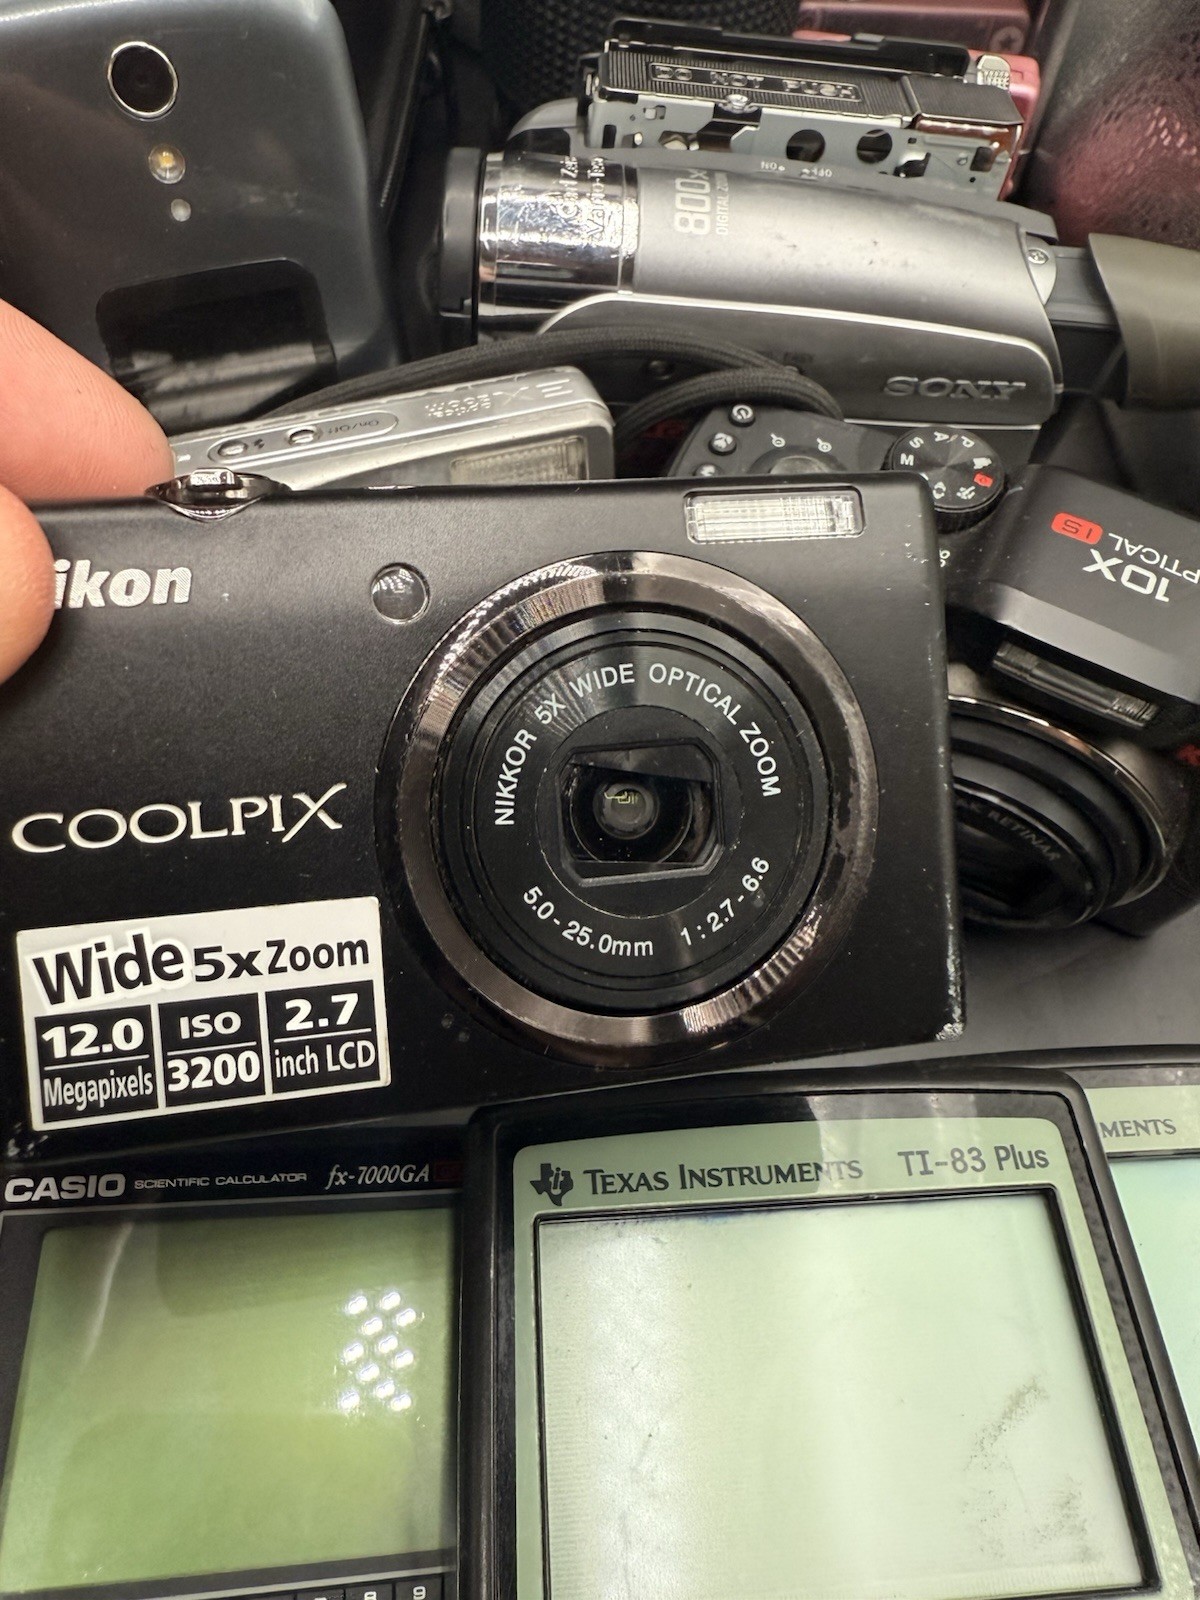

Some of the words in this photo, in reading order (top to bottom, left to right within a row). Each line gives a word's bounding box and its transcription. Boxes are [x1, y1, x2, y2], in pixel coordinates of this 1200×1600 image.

[709, 71, 765, 89] NOT
[715, 194, 730, 236] DIGITAL
[883, 375, 1027, 400] SONY
[326, 417, 380, 435] On/Off
[909, 436, 925, 449] S
[934, 431, 949, 442] A
[961, 435, 975, 449] P
[900, 452, 915, 466] M
[1060, 517, 1095, 541] IS
[1081, 547, 1171, 603] 10X
[1107, 532, 1200, 585] PTICAL
[53, 558, 193, 610] ikon
[493, 728, 538, 826] NIKKOR
[534, 693, 567, 725] 5X
[569, 662, 636, 698] WIDE
[648, 662, 743, 726] OPTICAL
[739, 721, 782, 798] ZOOM
[11, 782, 348, 854] COOLPIX
[31, 933, 187, 1006] Wide
[178, 1010, 242, 1040] ISO
[285, 992, 360, 1031] 2.7
[41, 1016, 145, 1060] 12.0
[166, 1051, 261, 1093] 3200
[274, 1042, 320, 1080] inch
[325, 1038, 376, 1073] LCD
[43, 1064, 154, 1110] Megapixels
[1099, 1118, 1177, 1139] MENTS
[4, 1172, 126, 1203] CASIO
[133, 1175, 210, 1191] SCIENTIFIC
[215, 1170, 308, 1187] CALCULATOR
[323, 1163, 430, 1191] fx-7000GA
[583, 1165, 670, 1196] TEXAS
[678, 1158, 864, 1190] INSTRUMENTS
[897, 1146, 987, 1178] TI-83
[994, 1143, 1050, 1172] Plus
